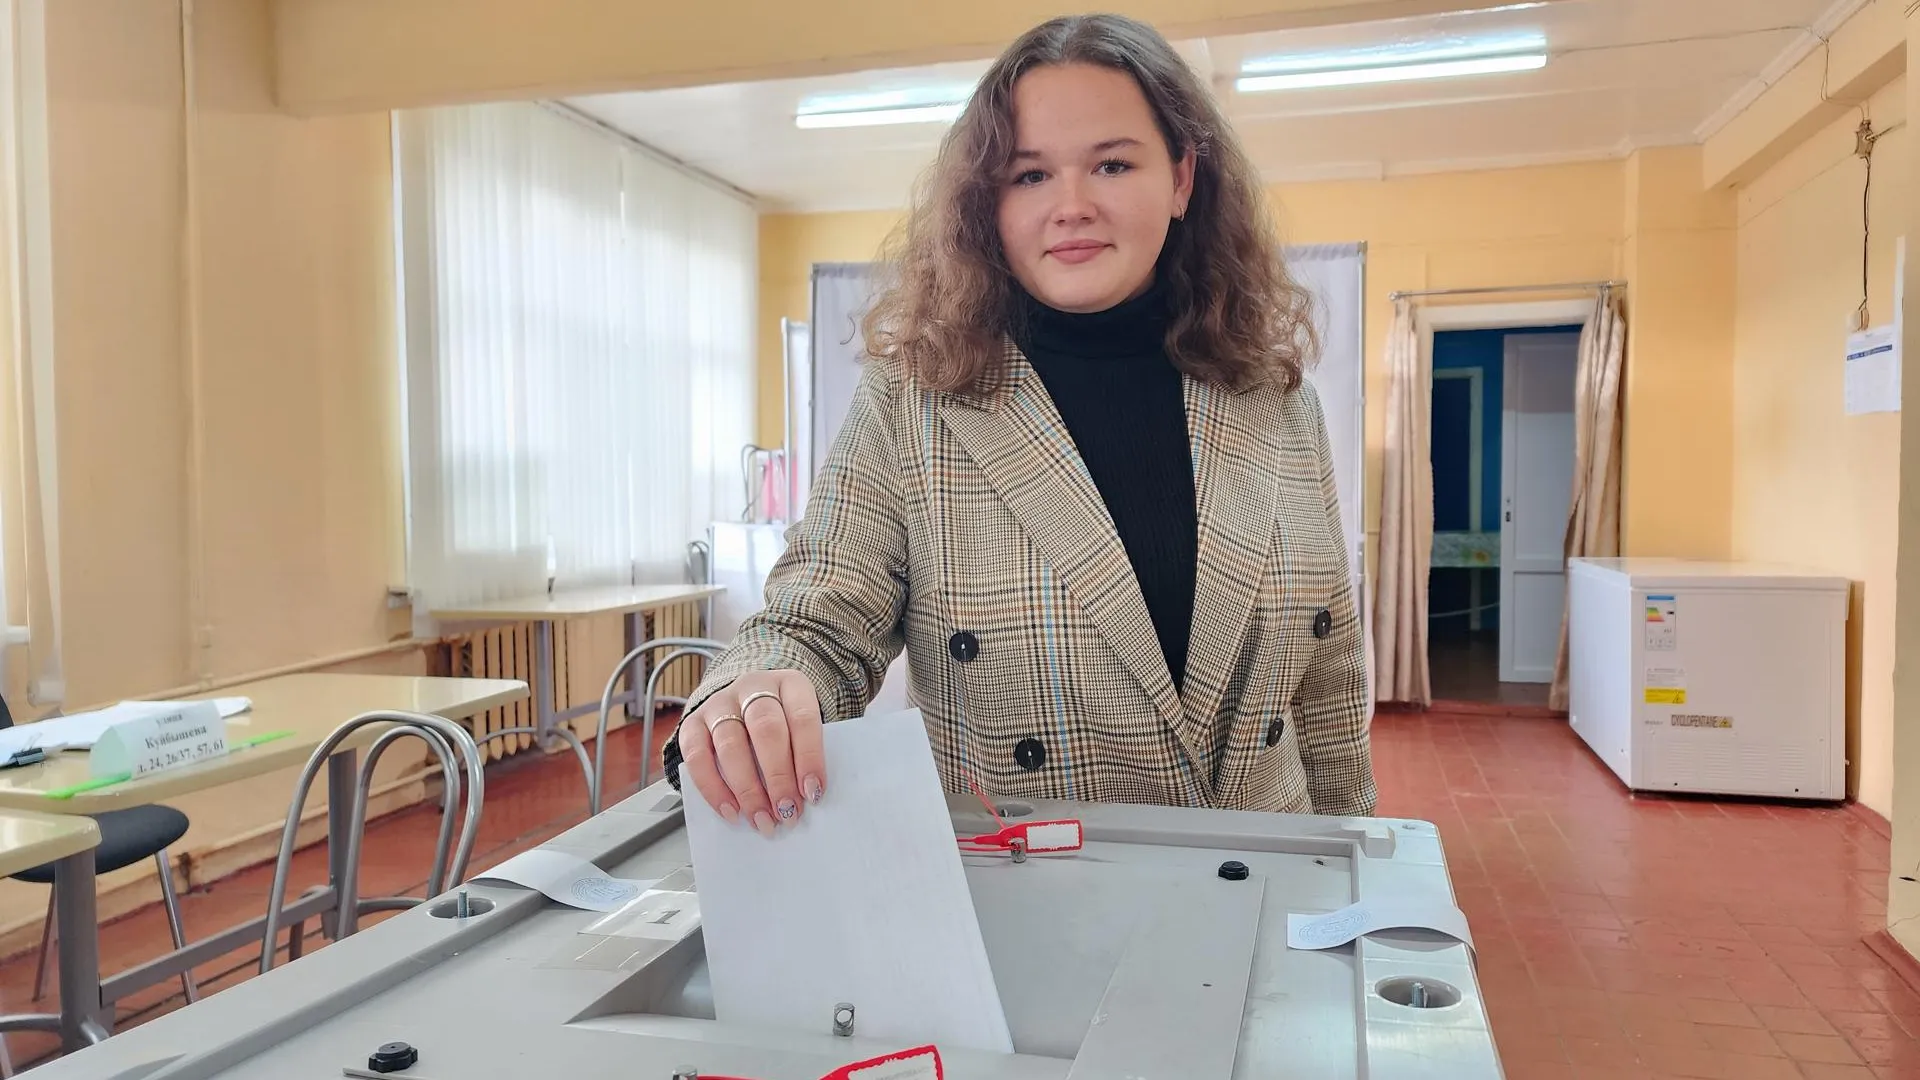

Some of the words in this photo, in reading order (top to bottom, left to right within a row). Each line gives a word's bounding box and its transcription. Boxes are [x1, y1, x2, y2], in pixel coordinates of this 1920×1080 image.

[145, 725, 207, 750] Куйбышева
[149, 757, 164, 771] 24,
[645, 909, 681, 925] 1
